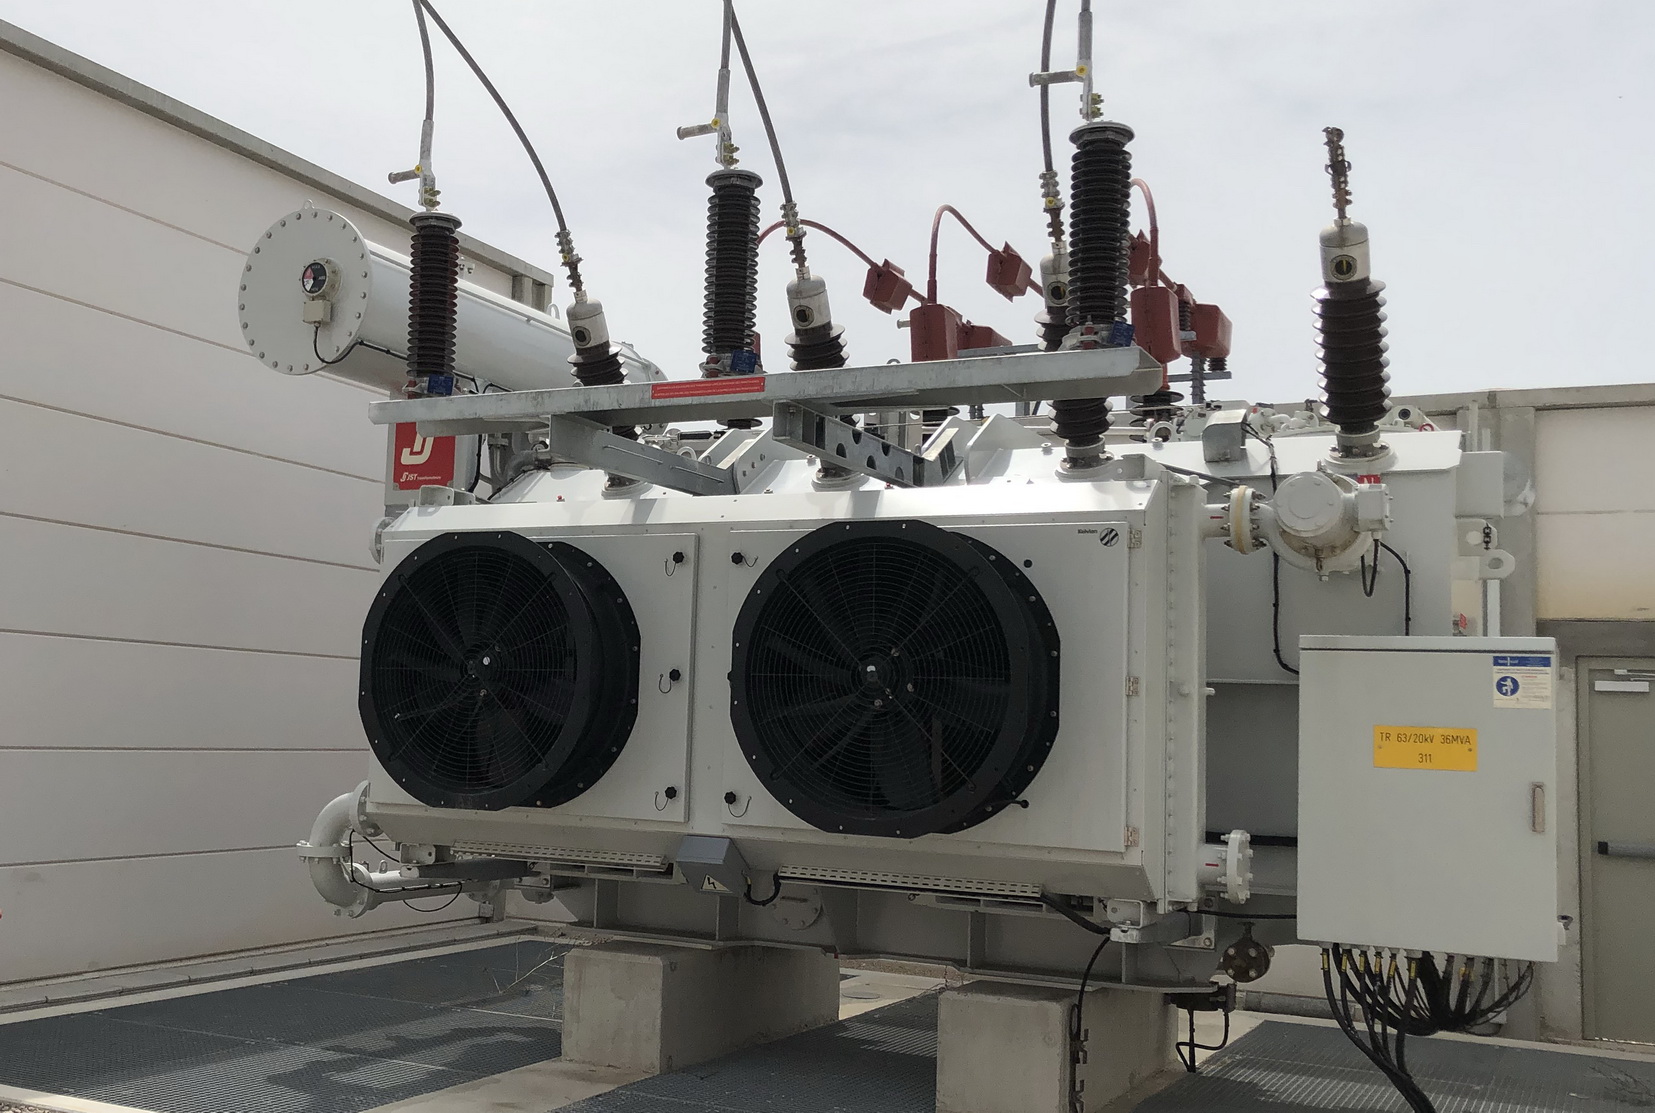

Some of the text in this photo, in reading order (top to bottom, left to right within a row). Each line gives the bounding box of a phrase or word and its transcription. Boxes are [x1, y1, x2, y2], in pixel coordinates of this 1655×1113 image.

[1379, 732, 1471, 745] TR 63/20kV 36MVA
[1418, 753, 1432, 763] 311
